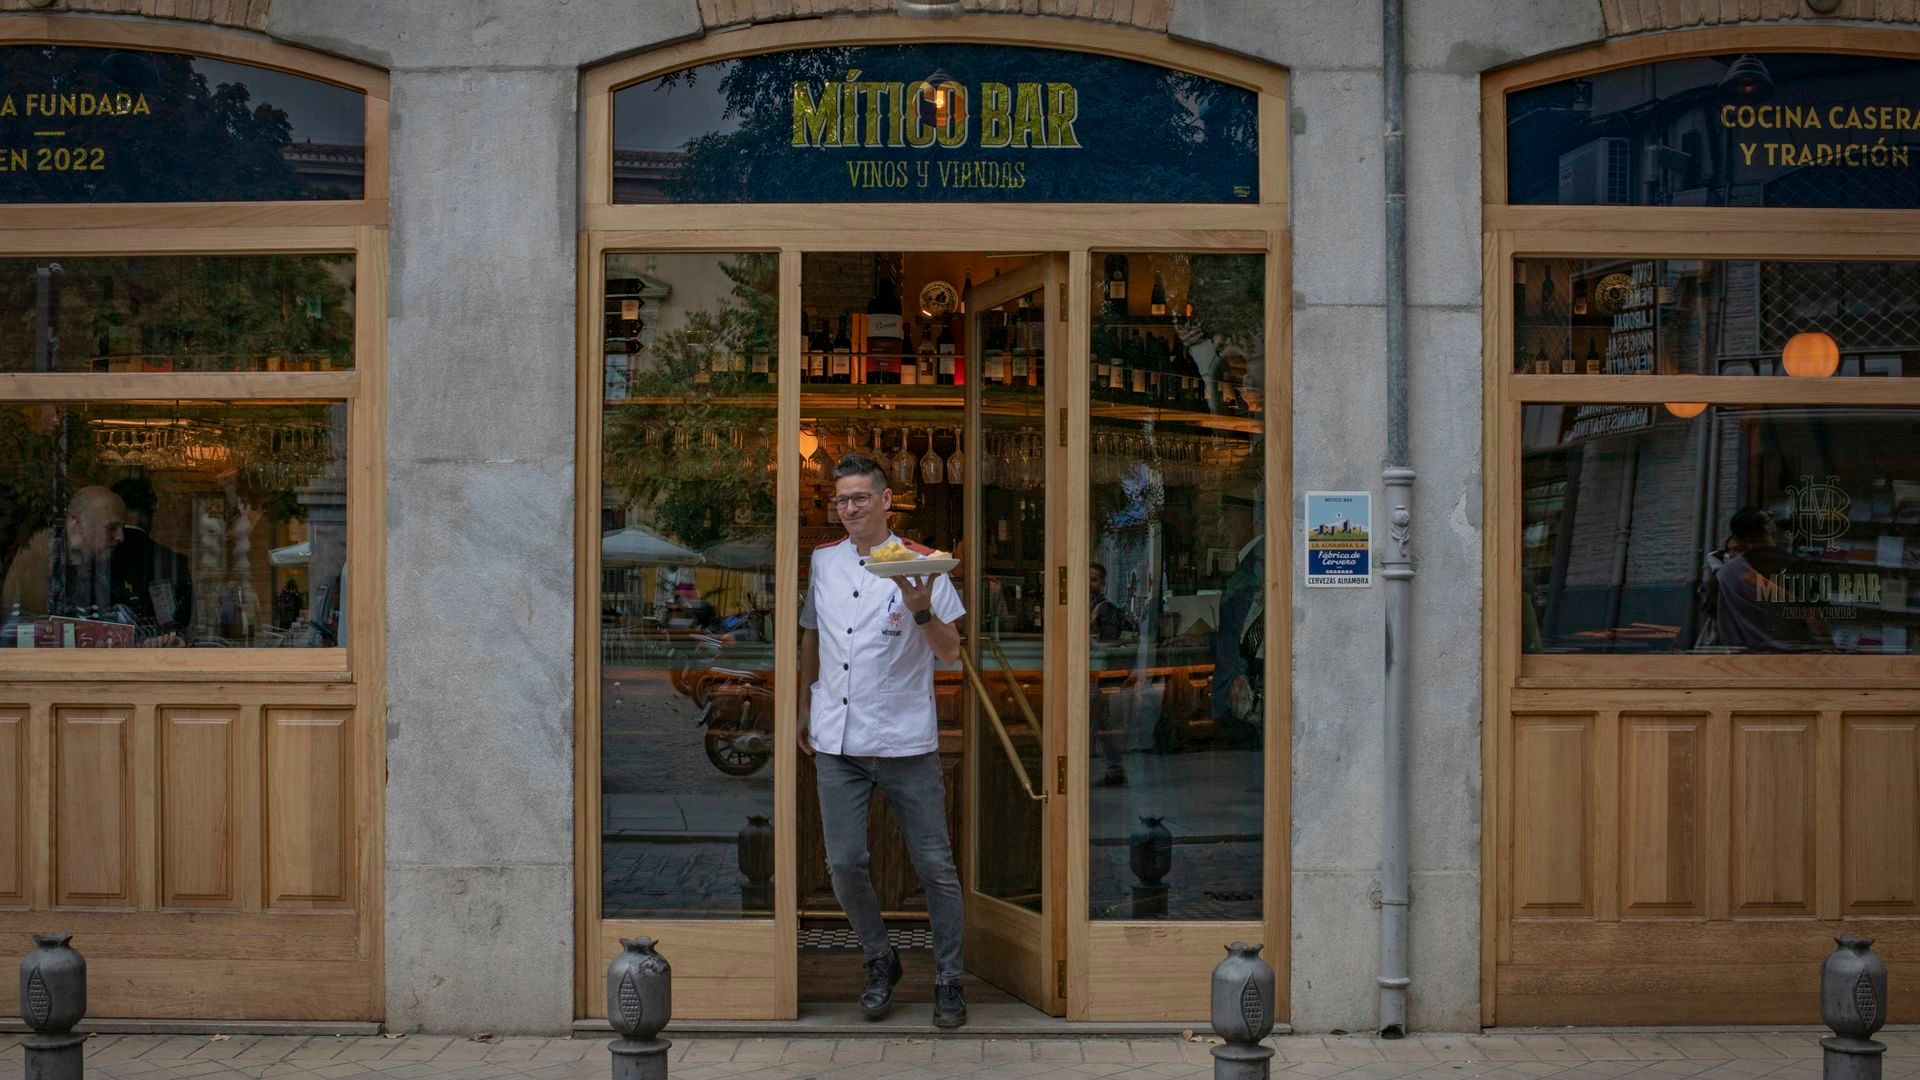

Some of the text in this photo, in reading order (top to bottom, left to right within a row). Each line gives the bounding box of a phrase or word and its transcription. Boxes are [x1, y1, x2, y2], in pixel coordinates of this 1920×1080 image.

[26, 93, 151, 117] FUNDADA
[791, 69, 1083, 149] MÍTICO BAR
[1720, 104, 1822, 129] COCINA
[36, 147, 105, 171] 2022
[1739, 137, 1909, 167] Y TRADICIÓN
[847, 160, 908, 188] VINOS
[937, 160, 1026, 189] VIANDAS
[1351, 550, 1361, 559] de
[1308, 577, 1369, 585] CERVEZAS ALHAMBRA
[1755, 568, 1882, 603] MÍTICO BAR
